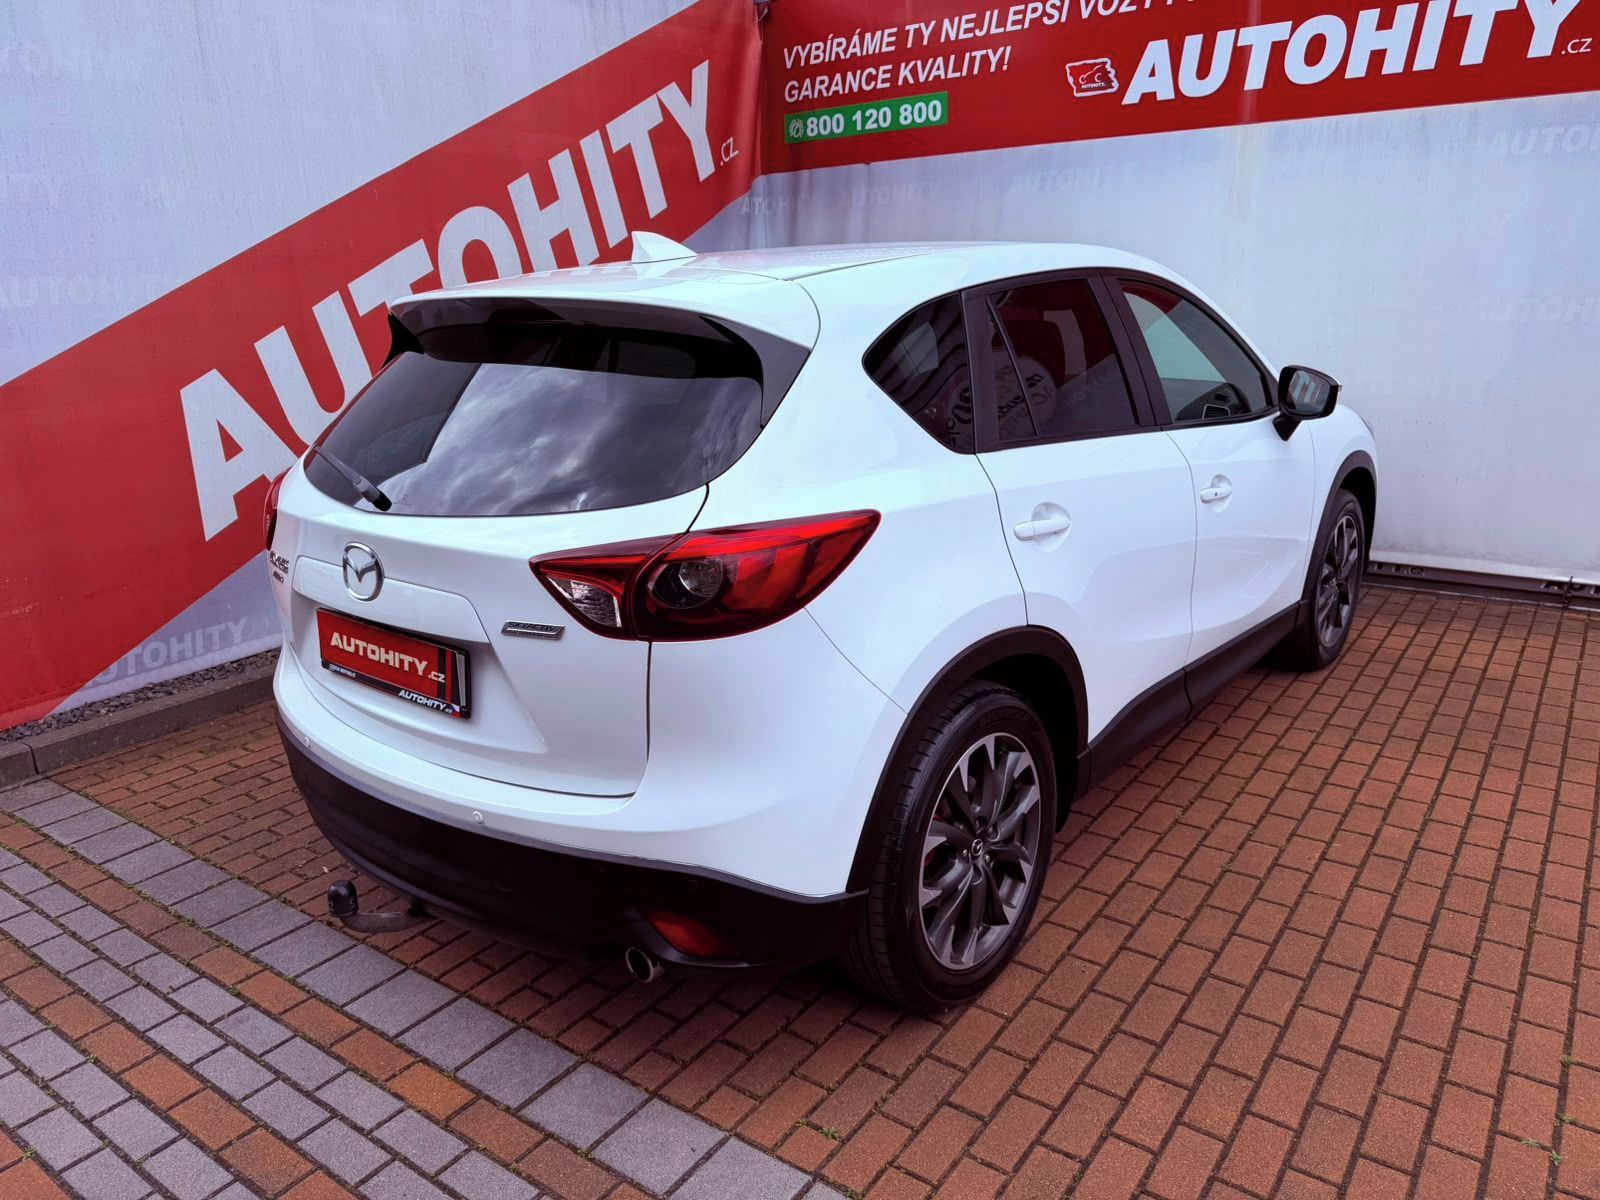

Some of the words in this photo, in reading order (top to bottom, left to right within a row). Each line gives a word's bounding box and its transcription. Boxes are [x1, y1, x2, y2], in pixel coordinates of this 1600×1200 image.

[784, 27, 897, 70] VYBÍRÁME
[905, 20, 938, 46] TY
[784, 65, 892, 103] GARANCE
[898, 46, 1011, 87] KVALITY!
[806, 112, 845, 137] 800
[851, 107, 892, 132] 120
[899, 100, 942, 125] 800
